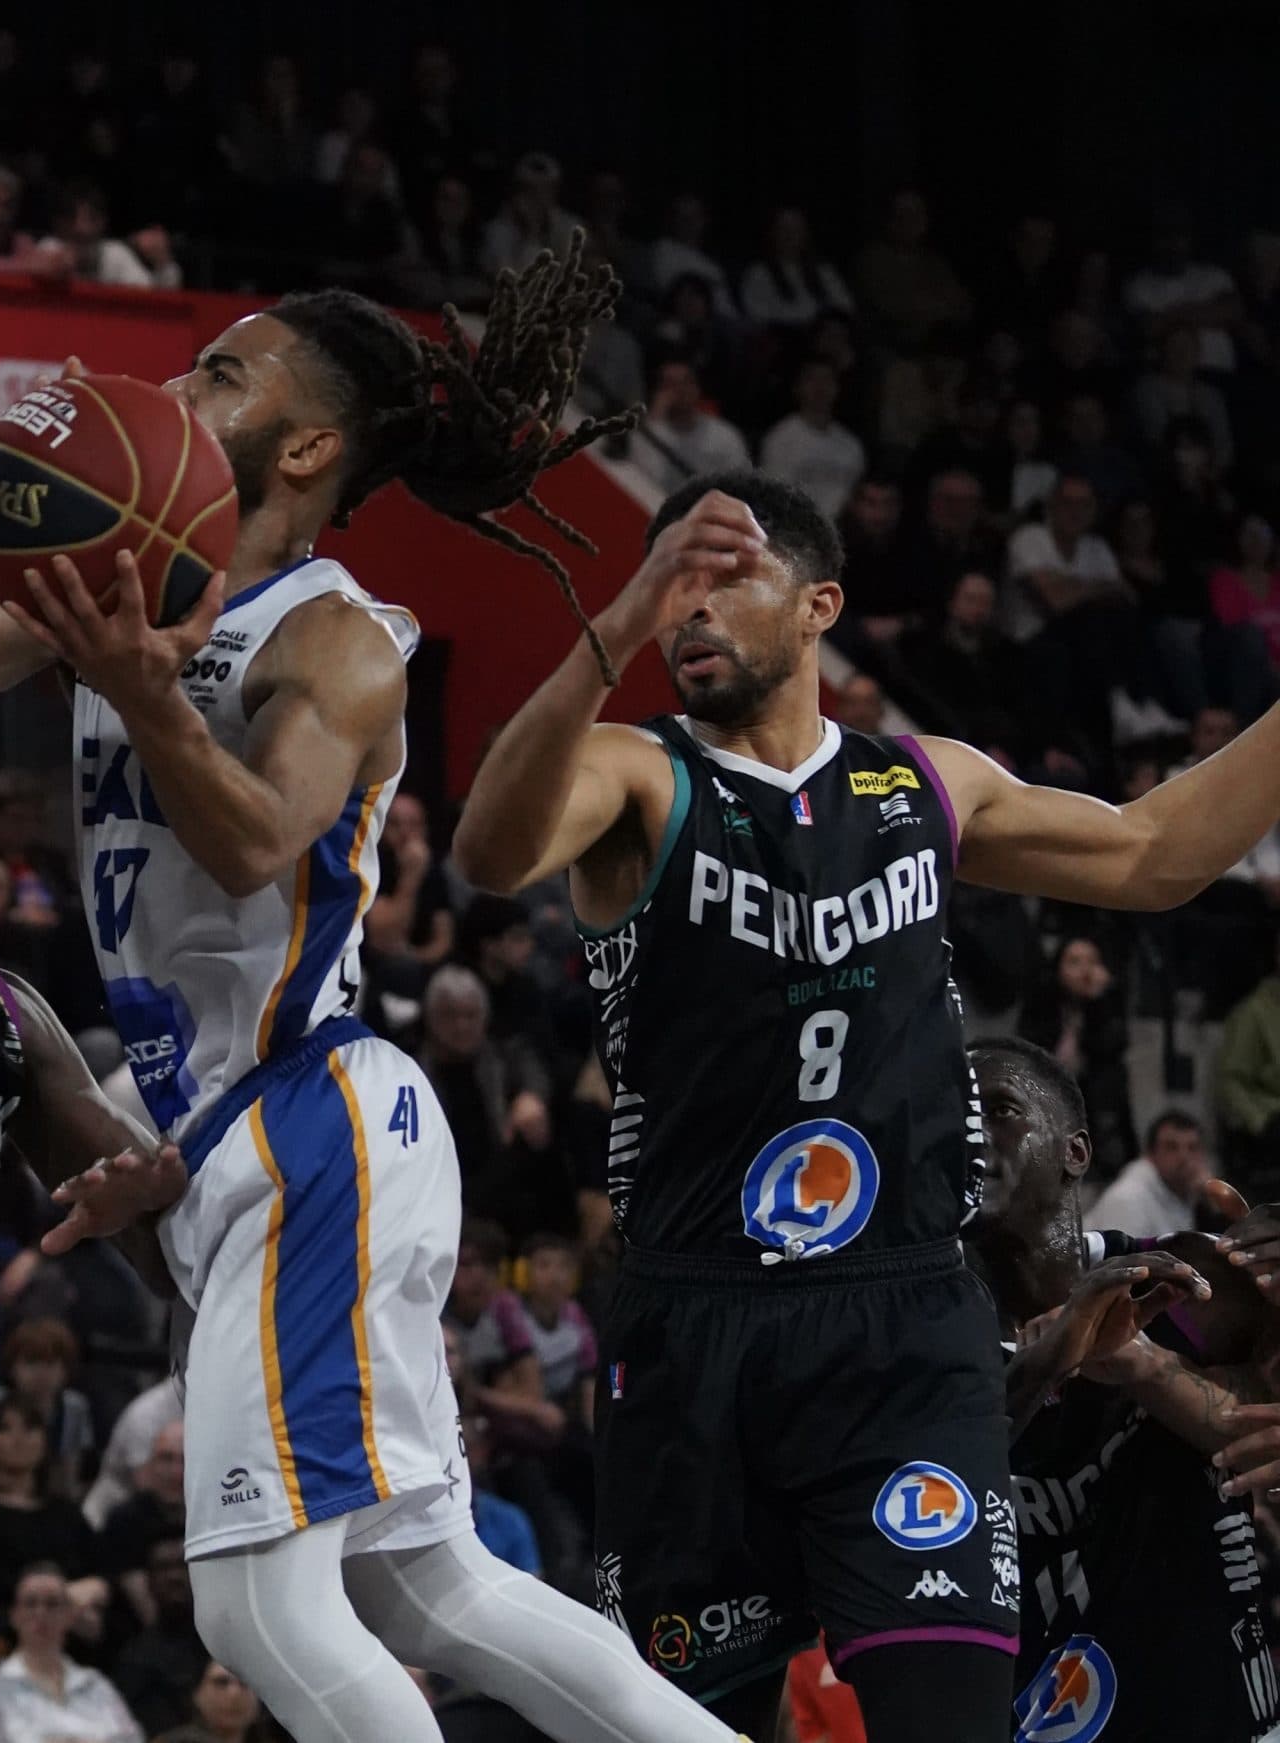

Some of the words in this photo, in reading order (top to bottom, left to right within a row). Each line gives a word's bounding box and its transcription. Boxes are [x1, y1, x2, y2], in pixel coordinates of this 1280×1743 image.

[853, 771, 913, 792] bpifrance
[688, 848, 940, 967] PERIGORD
[798, 1009, 850, 1103] 8
[221, 1486, 261, 1507] SKILLS
[699, 1594, 771, 1643] gie
